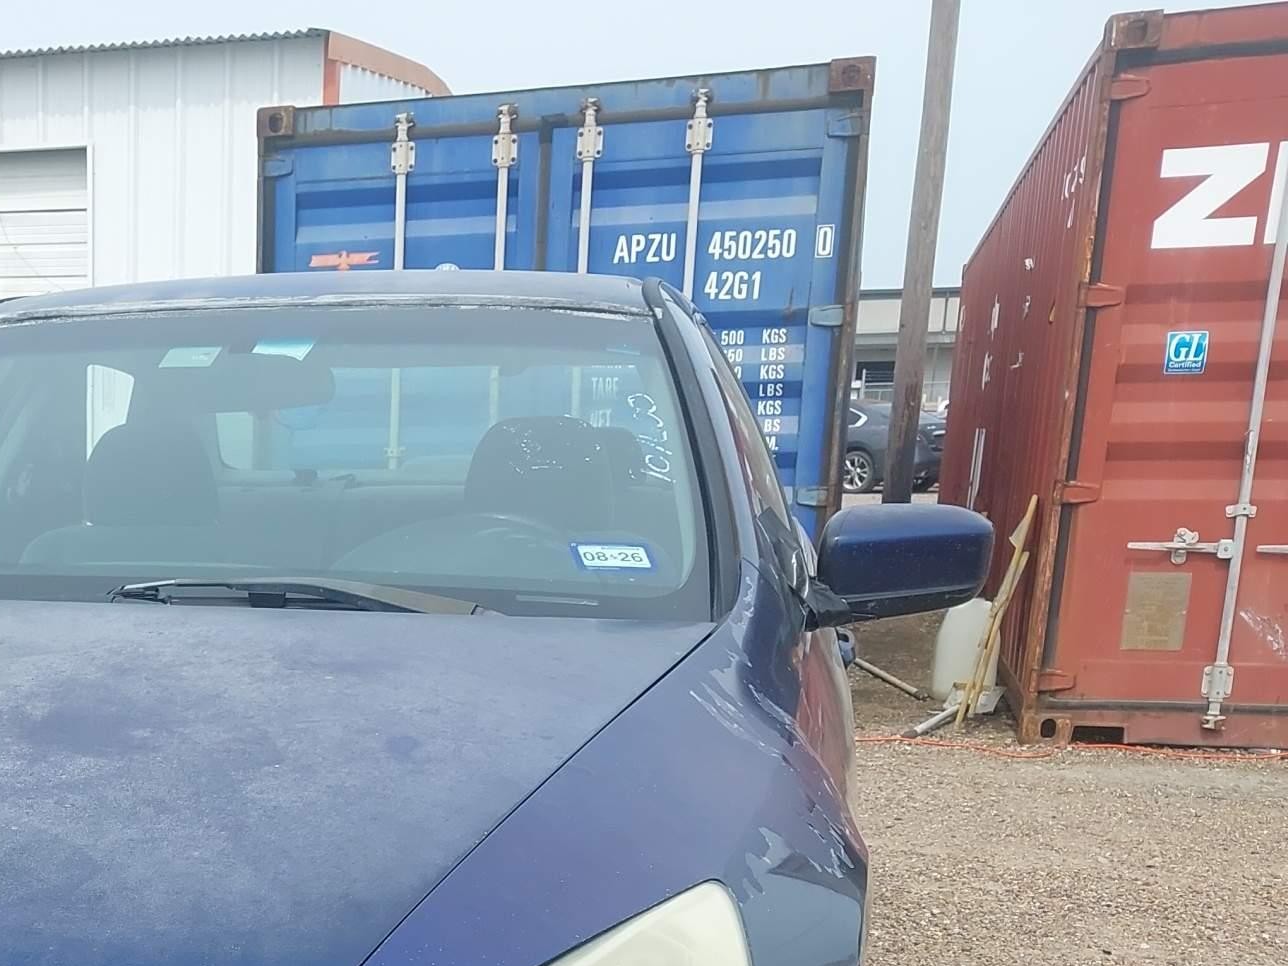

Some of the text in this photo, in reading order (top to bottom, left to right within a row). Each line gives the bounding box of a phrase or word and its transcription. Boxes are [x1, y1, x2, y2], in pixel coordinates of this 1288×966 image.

[613, 233, 677, 264] APZU
[708, 229, 797, 260] 450250
[704, 271, 761, 300] 42G1
[762, 329, 787, 344] KGS
[760, 347, 785, 361] LBS
[1169, 333, 1204, 362] GL
[759, 364, 785, 380] KGS
[758, 383, 783, 397] LBS
[757, 401, 782, 415] KGS
[764, 418, 781, 432] BS
